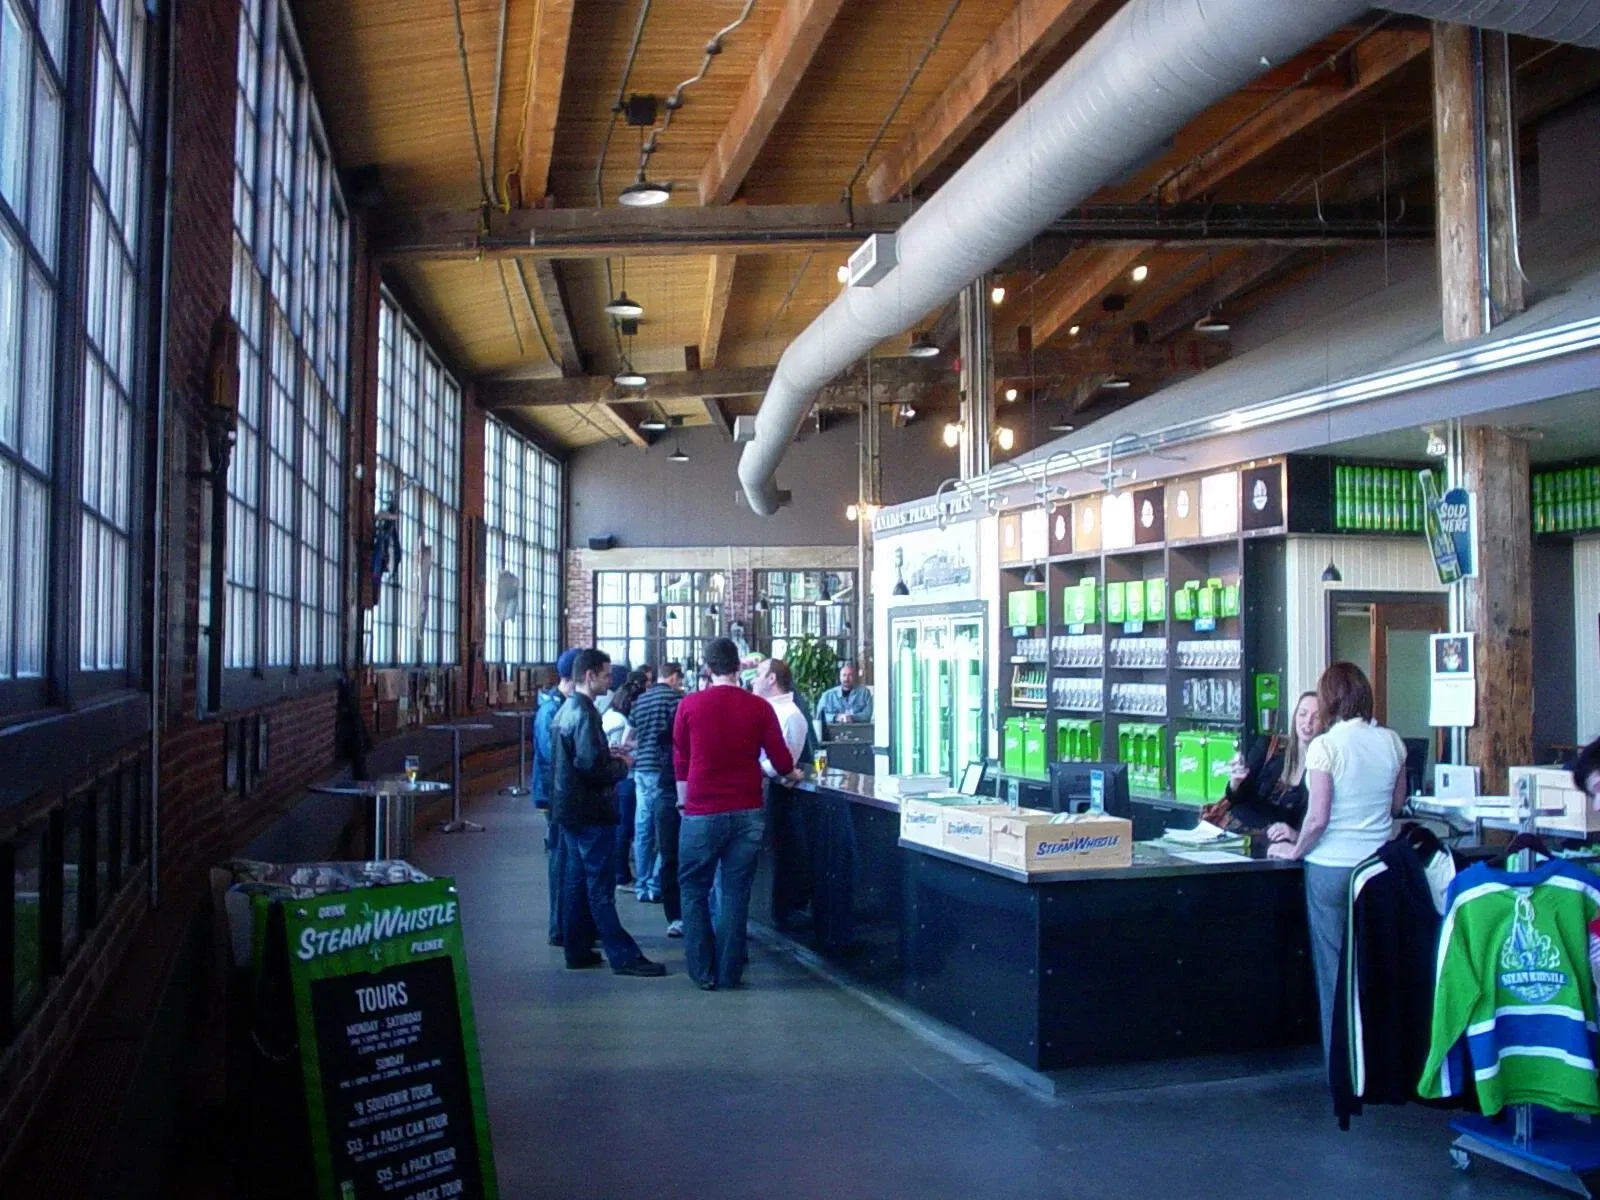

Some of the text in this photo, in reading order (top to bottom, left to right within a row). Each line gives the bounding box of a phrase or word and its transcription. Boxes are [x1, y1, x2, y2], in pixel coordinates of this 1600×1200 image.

[1440, 503, 1467, 518] SOLD
[1441, 518, 1468, 533] HERE
[355, 981, 409, 1014] TOURS
[345, 1020, 379, 1037] MONDAY
[386, 1010, 423, 1029] SATURDAY
[375, 1053, 405, 1071] SUNDAY
[365, 1089, 409, 1114] SOUVENIR
[410, 1083, 433, 1100] TOUR
[380, 1126, 404, 1144] PACK
[406, 1120, 426, 1137] CAN
[425, 1112, 449, 1131] TOUR
[409, 1153, 433, 1172] PACK
[433, 1146, 457, 1164] TOUR
[440, 1179, 464, 1198] TOUR
